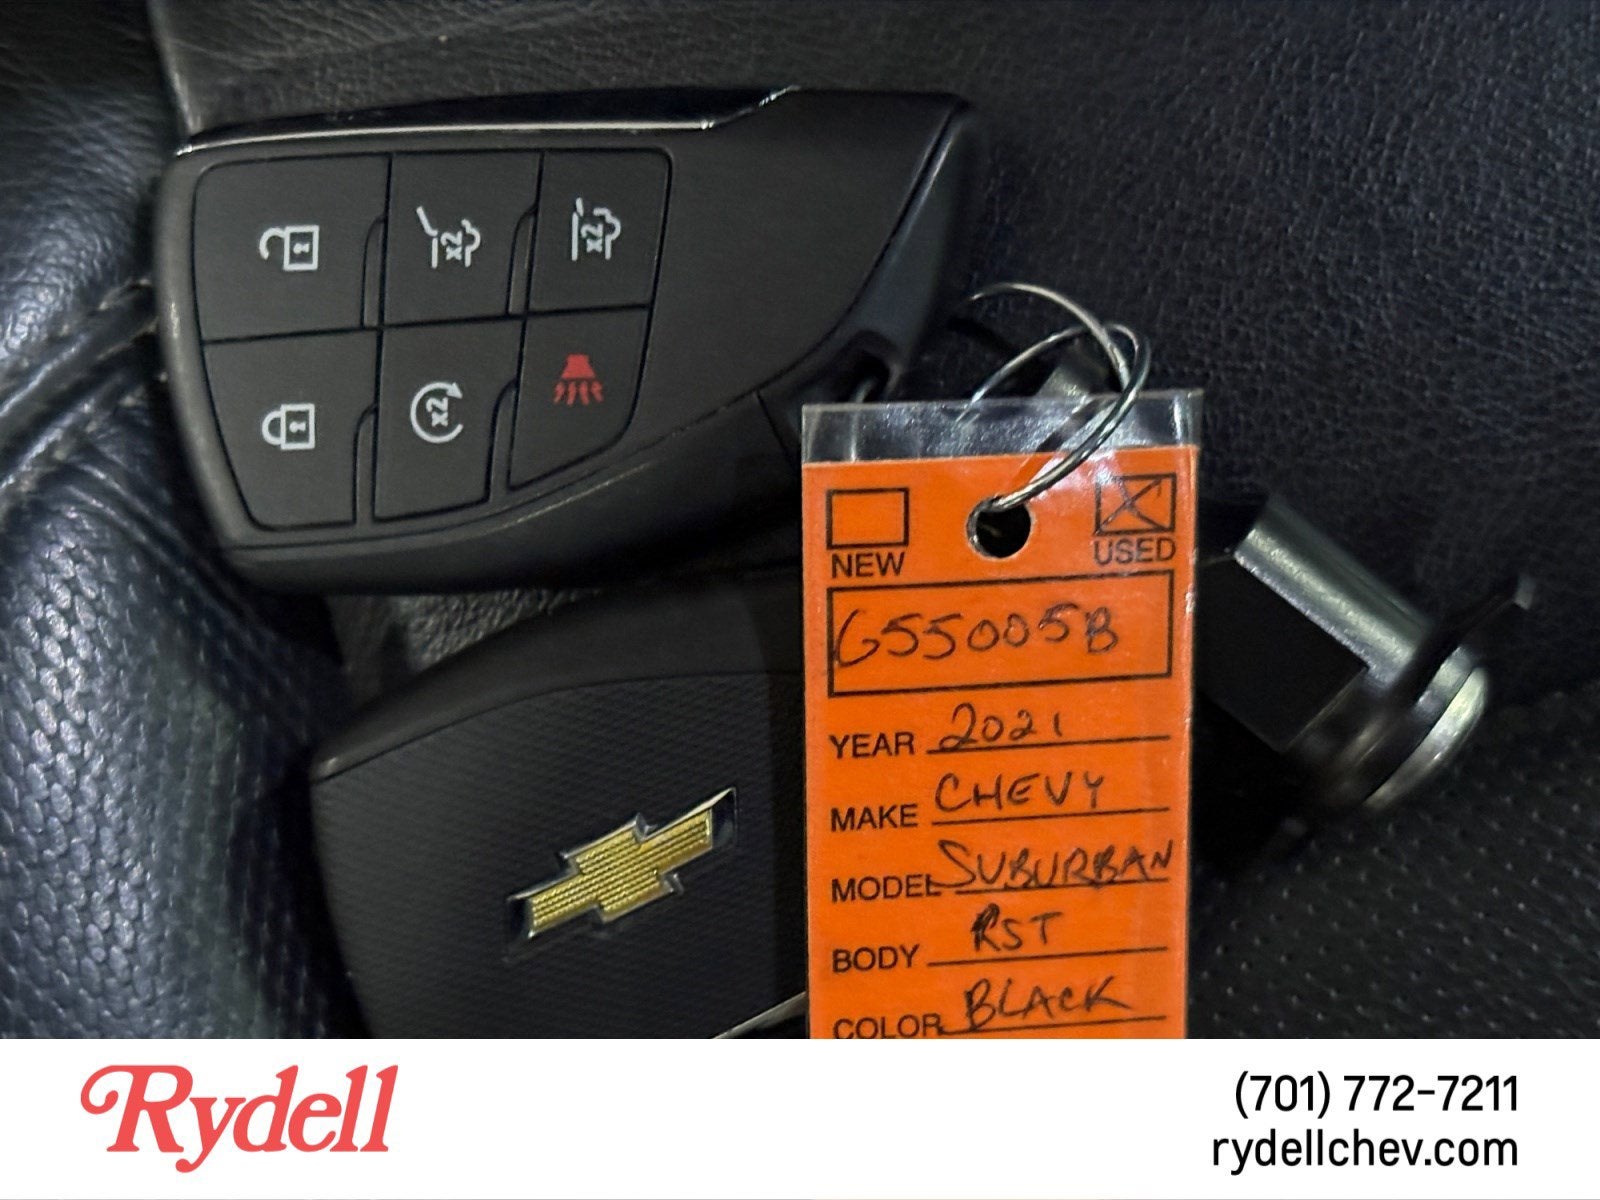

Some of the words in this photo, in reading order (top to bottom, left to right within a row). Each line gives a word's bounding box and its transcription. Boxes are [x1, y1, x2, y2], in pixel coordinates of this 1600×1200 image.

[831, 553, 905, 578] NEW
[1094, 537, 1177, 566] USED
[830, 733, 915, 760] YEAR
[938, 702, 1063, 753] 2021
[830, 804, 919, 832] MAKE
[934, 772, 1104, 812] CHEVY
[831, 874, 942, 902] MODEL
[930, 839, 1173, 889] SUBURBAN
[832, 944, 920, 973] BODY
[970, 902, 1063, 951] RST
[833, 1013, 942, 1039] COLOR
[963, 975, 1133, 1032] BLACK
